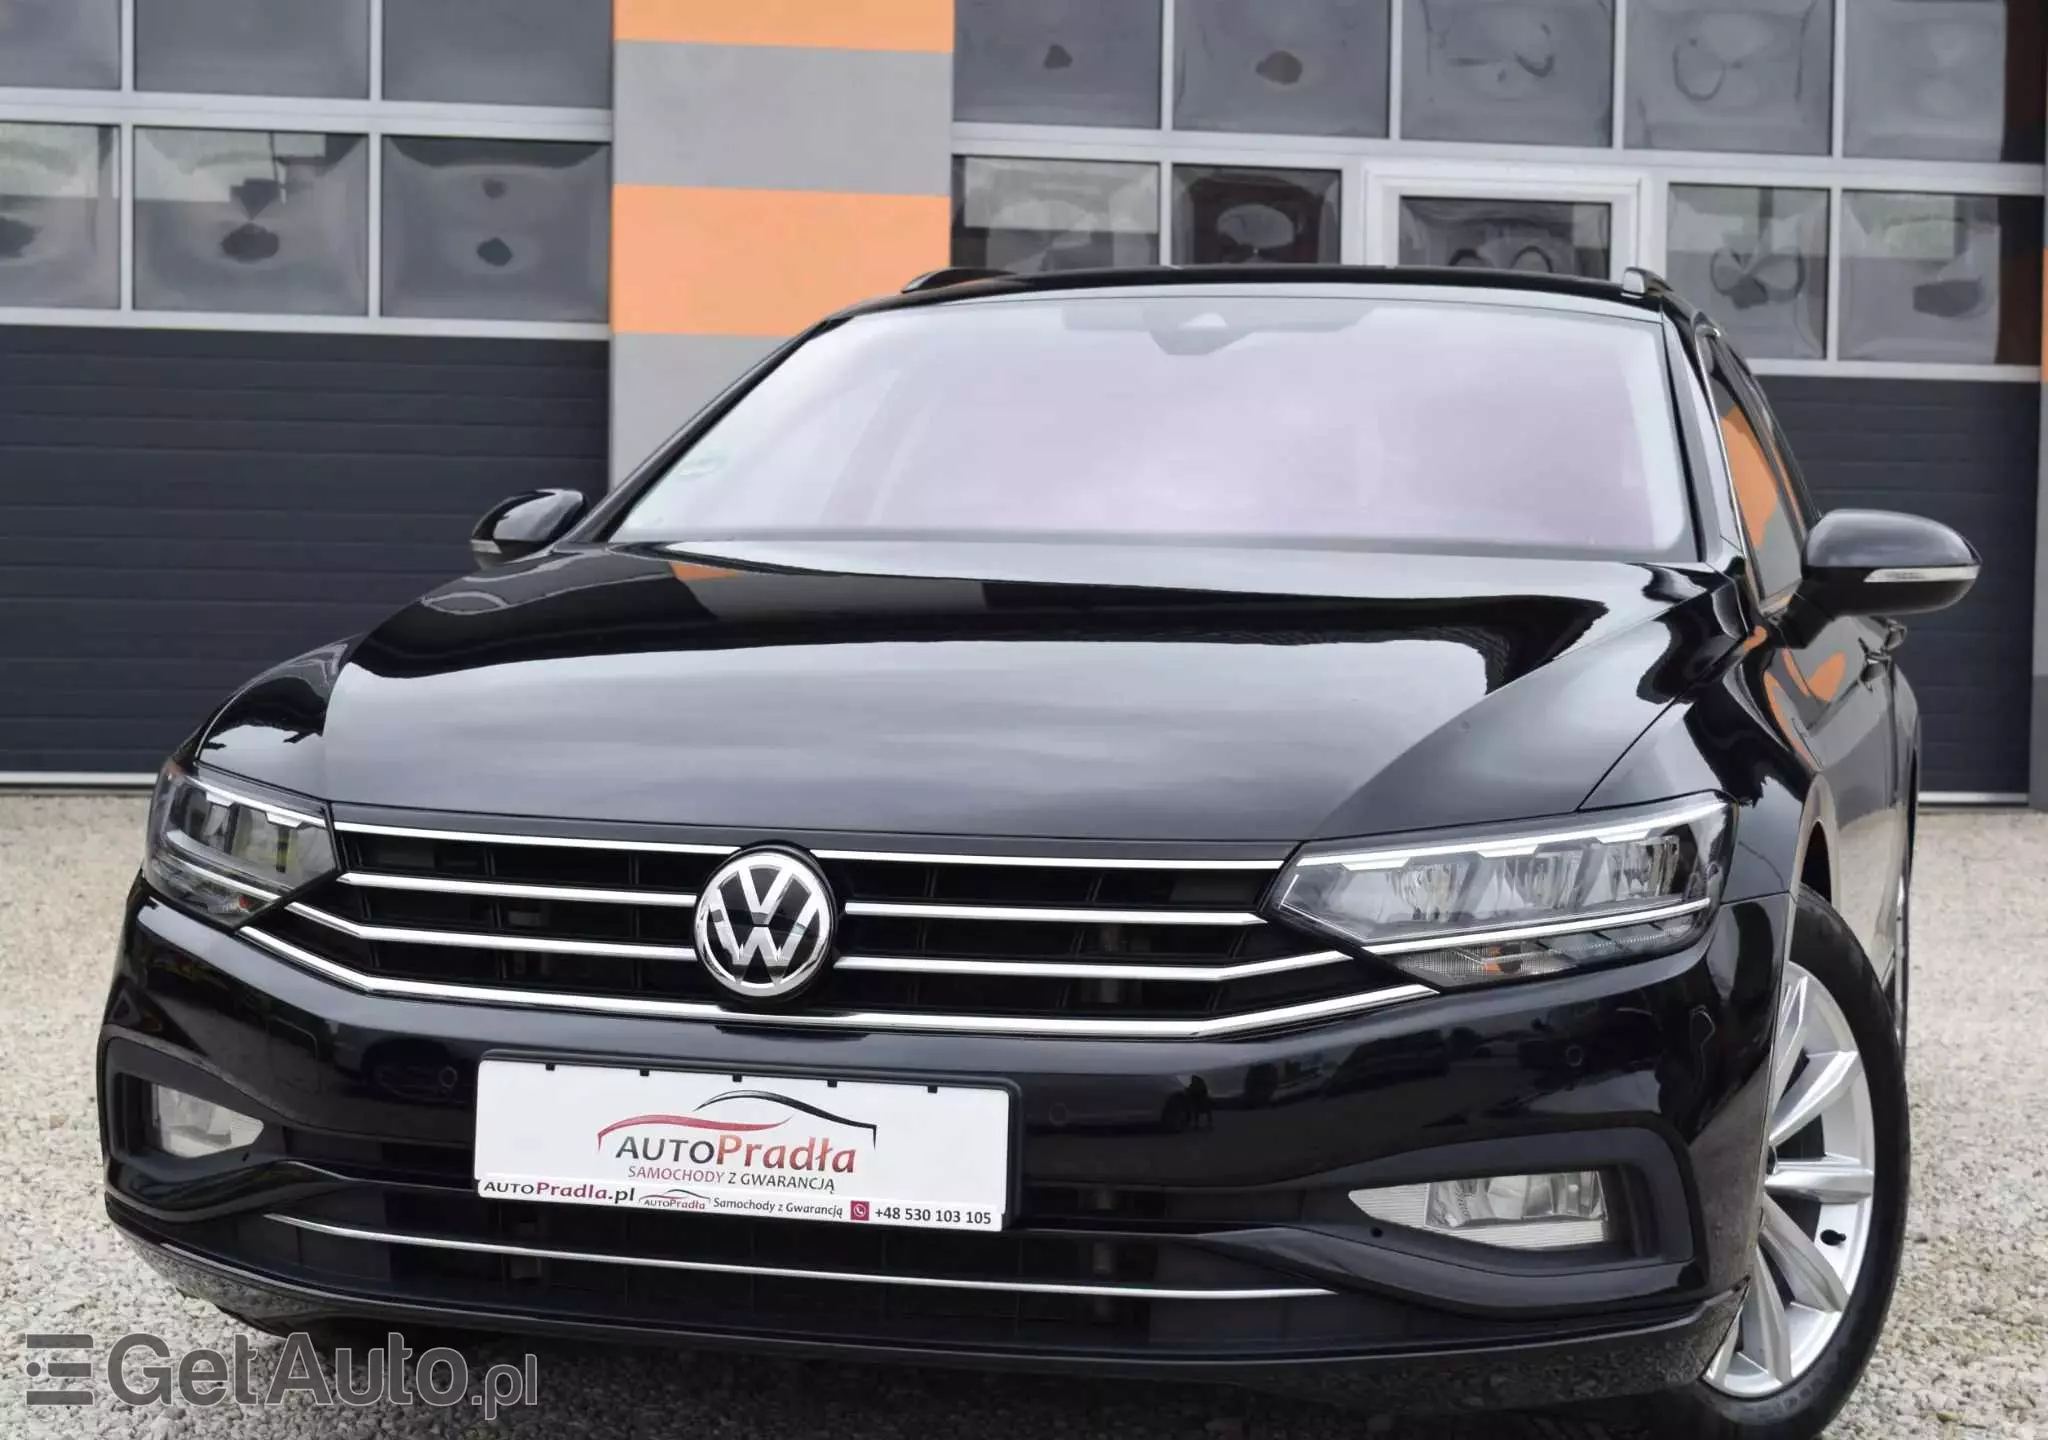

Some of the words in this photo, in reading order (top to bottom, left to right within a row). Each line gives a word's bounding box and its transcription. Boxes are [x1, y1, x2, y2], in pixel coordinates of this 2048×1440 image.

[615, 1134, 857, 1173] AUTOPradła
[628, 1165, 725, 1184] SAMOCHODY
[728, 1172, 737, 1185] Z
[740, 1173, 835, 1194] GWARANCJĄ
[483, 1181, 635, 1204] AUTOPradla.pl
[713, 1198, 775, 1214] Samochody
[778, 1203, 784, 1212] z
[786, 1202, 843, 1219] Gwarancją
[875, 1205, 901, 1220] +48
[905, 1207, 931, 1222] 530
[935, 1209, 961, 1223] 103
[965, 1210, 992, 1225] 105
